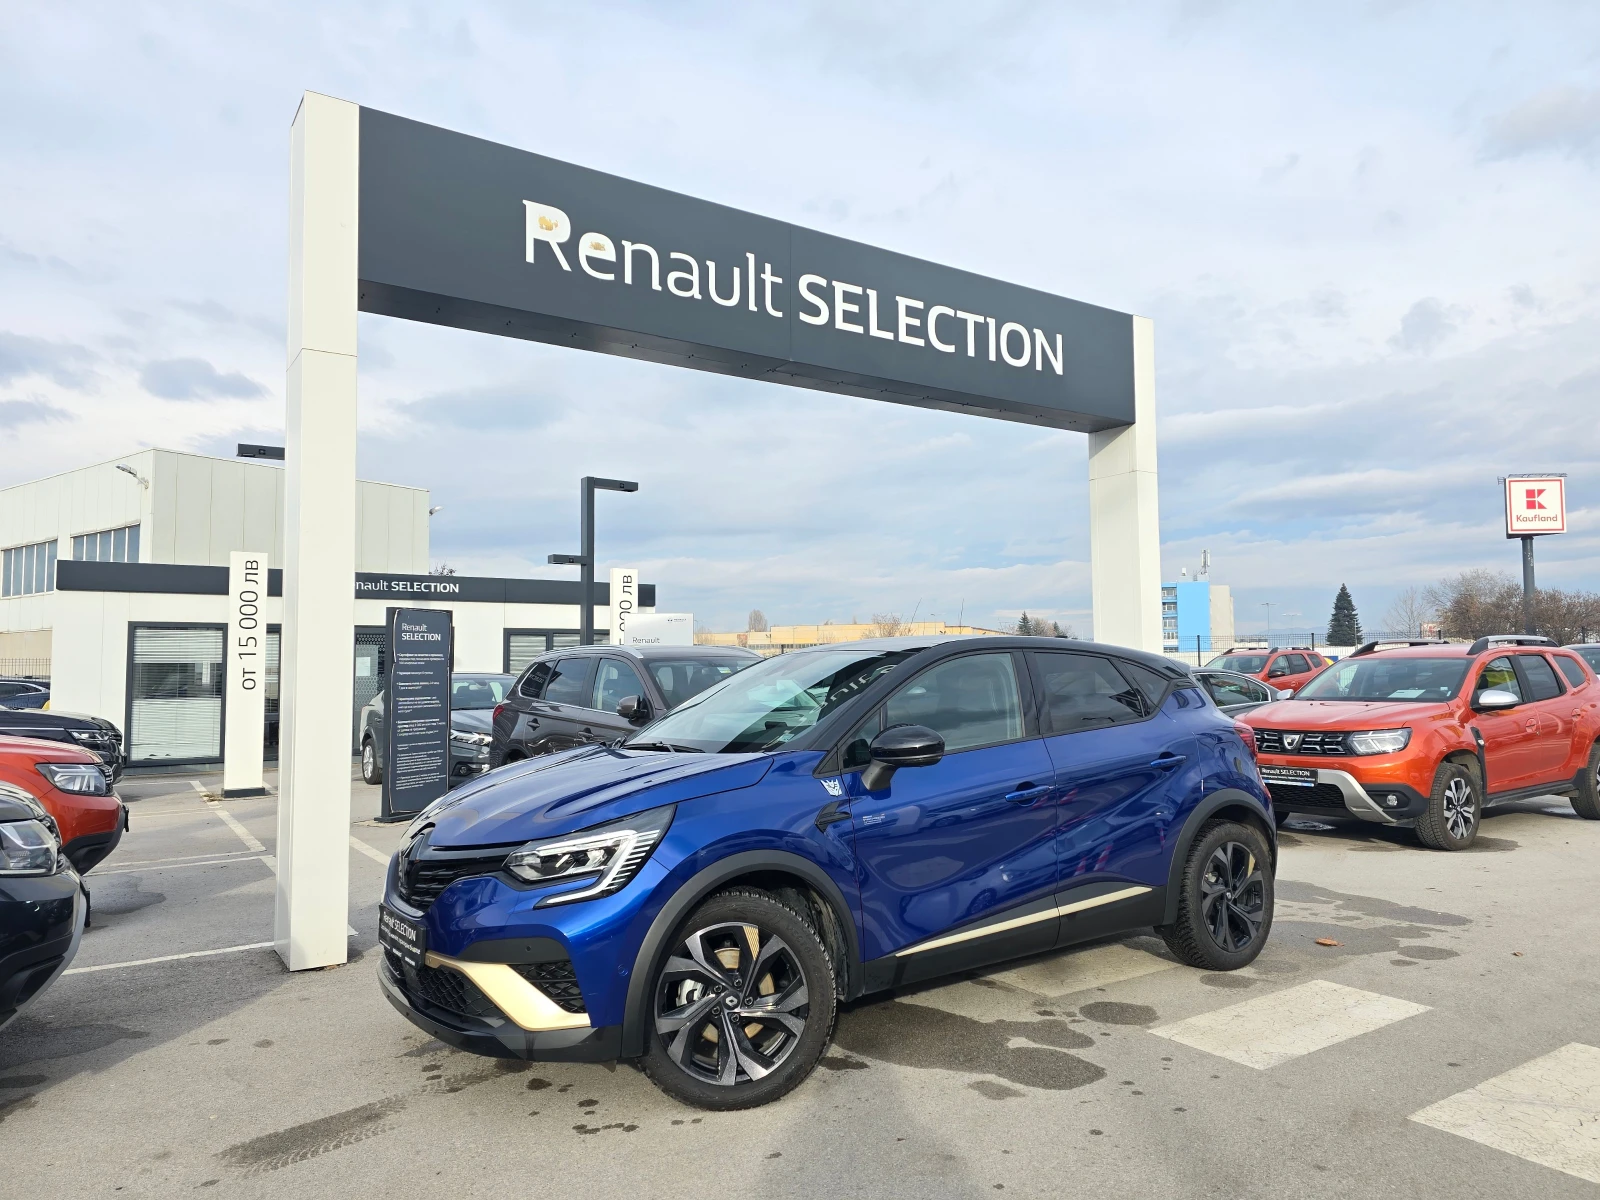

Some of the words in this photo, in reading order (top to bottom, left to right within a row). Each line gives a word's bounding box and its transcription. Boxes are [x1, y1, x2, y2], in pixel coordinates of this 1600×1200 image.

[522, 199, 784, 318] Renault
[798, 273, 1064, 376] SELECTION
[1516, 514, 1558, 523] Kaufland
[355, 579, 389, 591] nault
[391, 581, 459, 593] SELECTION
[238, 590, 259, 630] 000
[401, 622, 428, 632] Renault
[401, 632, 441, 642] SELECTION
[632, 636, 660, 644] Renault
[238, 636, 258, 660] 15
[394, 919, 417, 942] SELECTION
